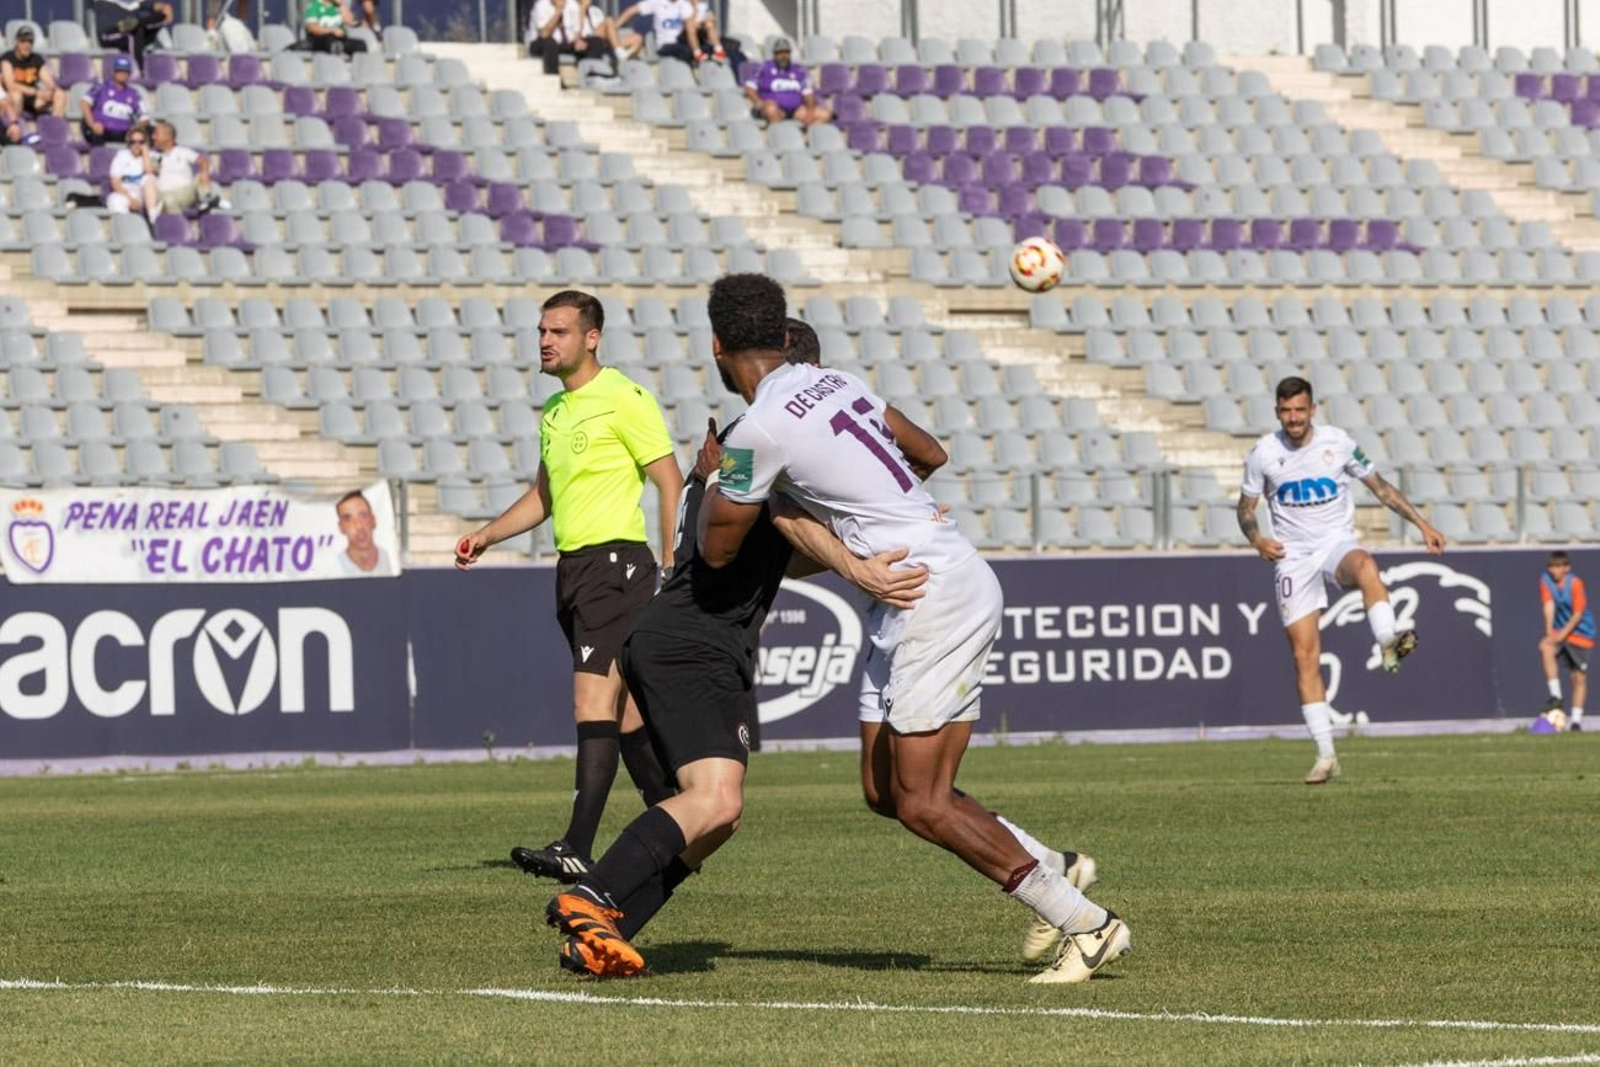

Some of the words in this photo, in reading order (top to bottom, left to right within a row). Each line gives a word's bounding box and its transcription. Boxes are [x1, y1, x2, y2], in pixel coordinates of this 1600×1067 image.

[784, 392, 815, 419] DE
[145, 501, 208, 531] REAL
[995, 603, 1221, 640] TECCION
[1237, 602, 1268, 636] Y
